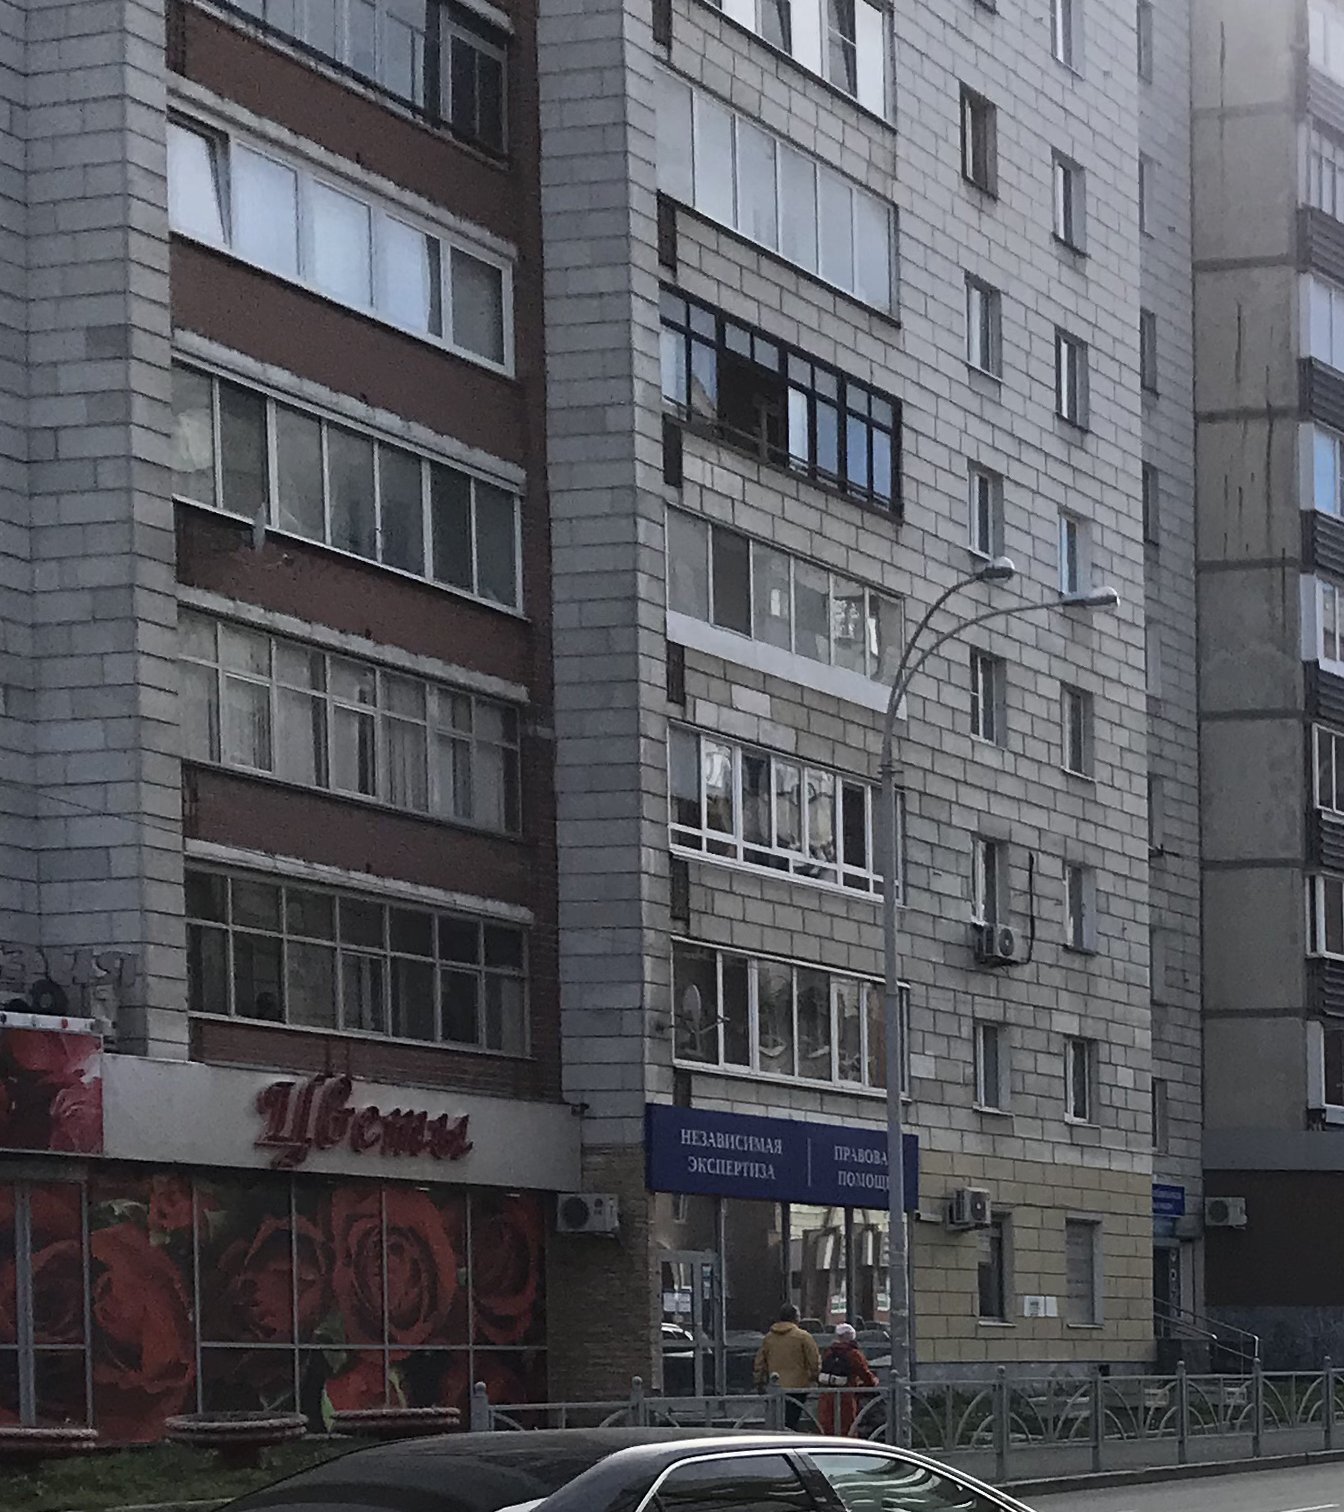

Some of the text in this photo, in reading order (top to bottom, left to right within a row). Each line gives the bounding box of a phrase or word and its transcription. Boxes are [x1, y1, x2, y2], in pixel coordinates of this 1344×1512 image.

[254, 1072, 475, 1168] Цветы
[680, 1128, 783, 1155] НЕЗАВИСИМАЯ
[834, 1145, 889, 1165] ПРАВОВА
[687, 1156, 776, 1180] ЭКСПЕРТИЗА
[838, 1170, 889, 1192] ПОМОЩ
